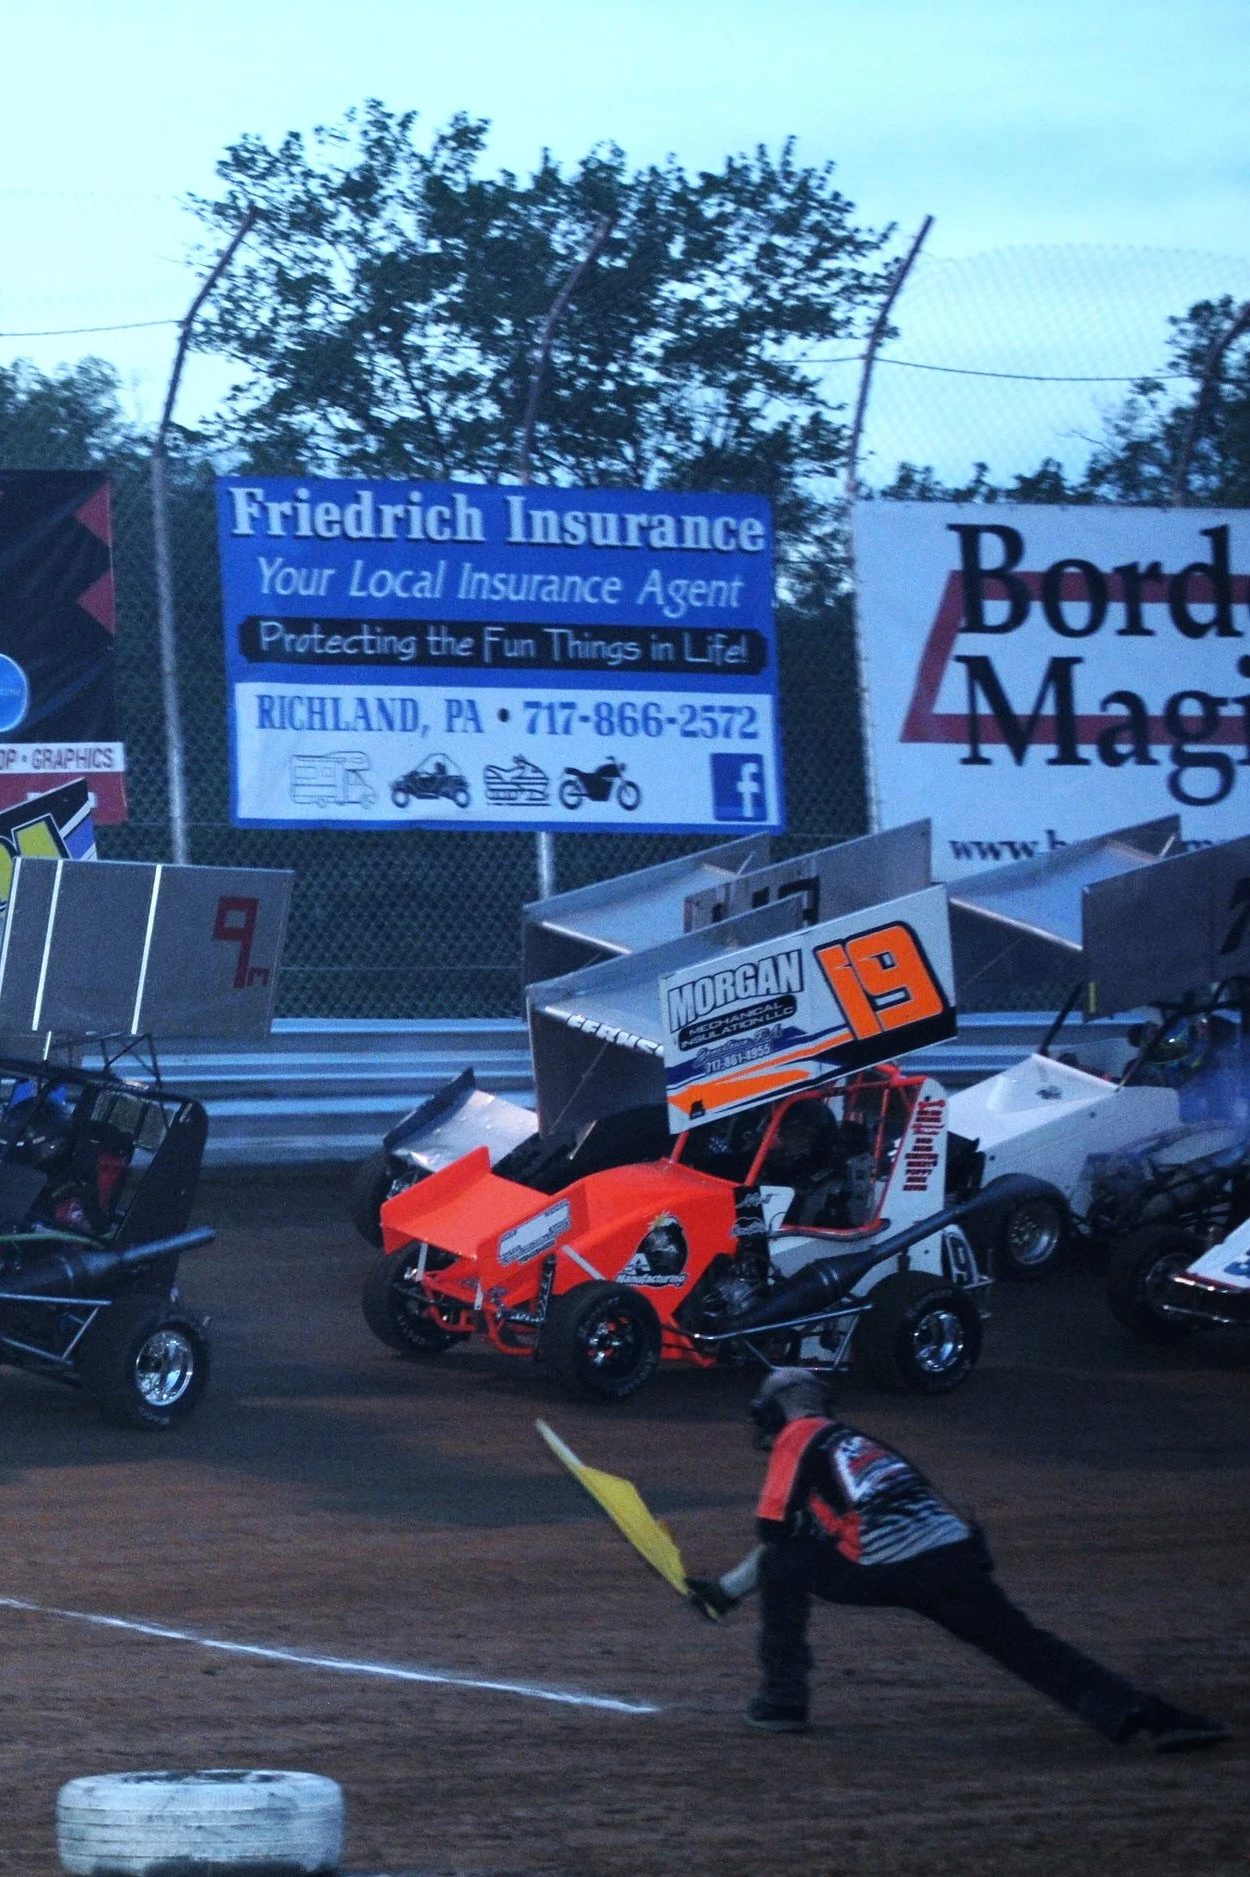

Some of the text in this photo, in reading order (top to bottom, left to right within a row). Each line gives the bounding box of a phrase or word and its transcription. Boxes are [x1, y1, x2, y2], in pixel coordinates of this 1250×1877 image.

[228, 487, 766, 552] Friedrich Insurance
[257, 557, 744, 619] Your Local Insurance Agent
[947, 523, 1250, 639] Bord
[259, 621, 748, 666] Protecting the Fun Things in Life!
[255, 694, 758, 740] RICHLAND, PA 717-866-2572
[32, 748, 115, 771] GRAPHICS
[668, 949, 804, 1034] MORGAN
[814, 921, 949, 1041] 19
[681, 1014, 764, 1049] INSULATION
[765, 1006, 795, 1023] LLC
[688, 1002, 783, 1036] MECHANICAL
